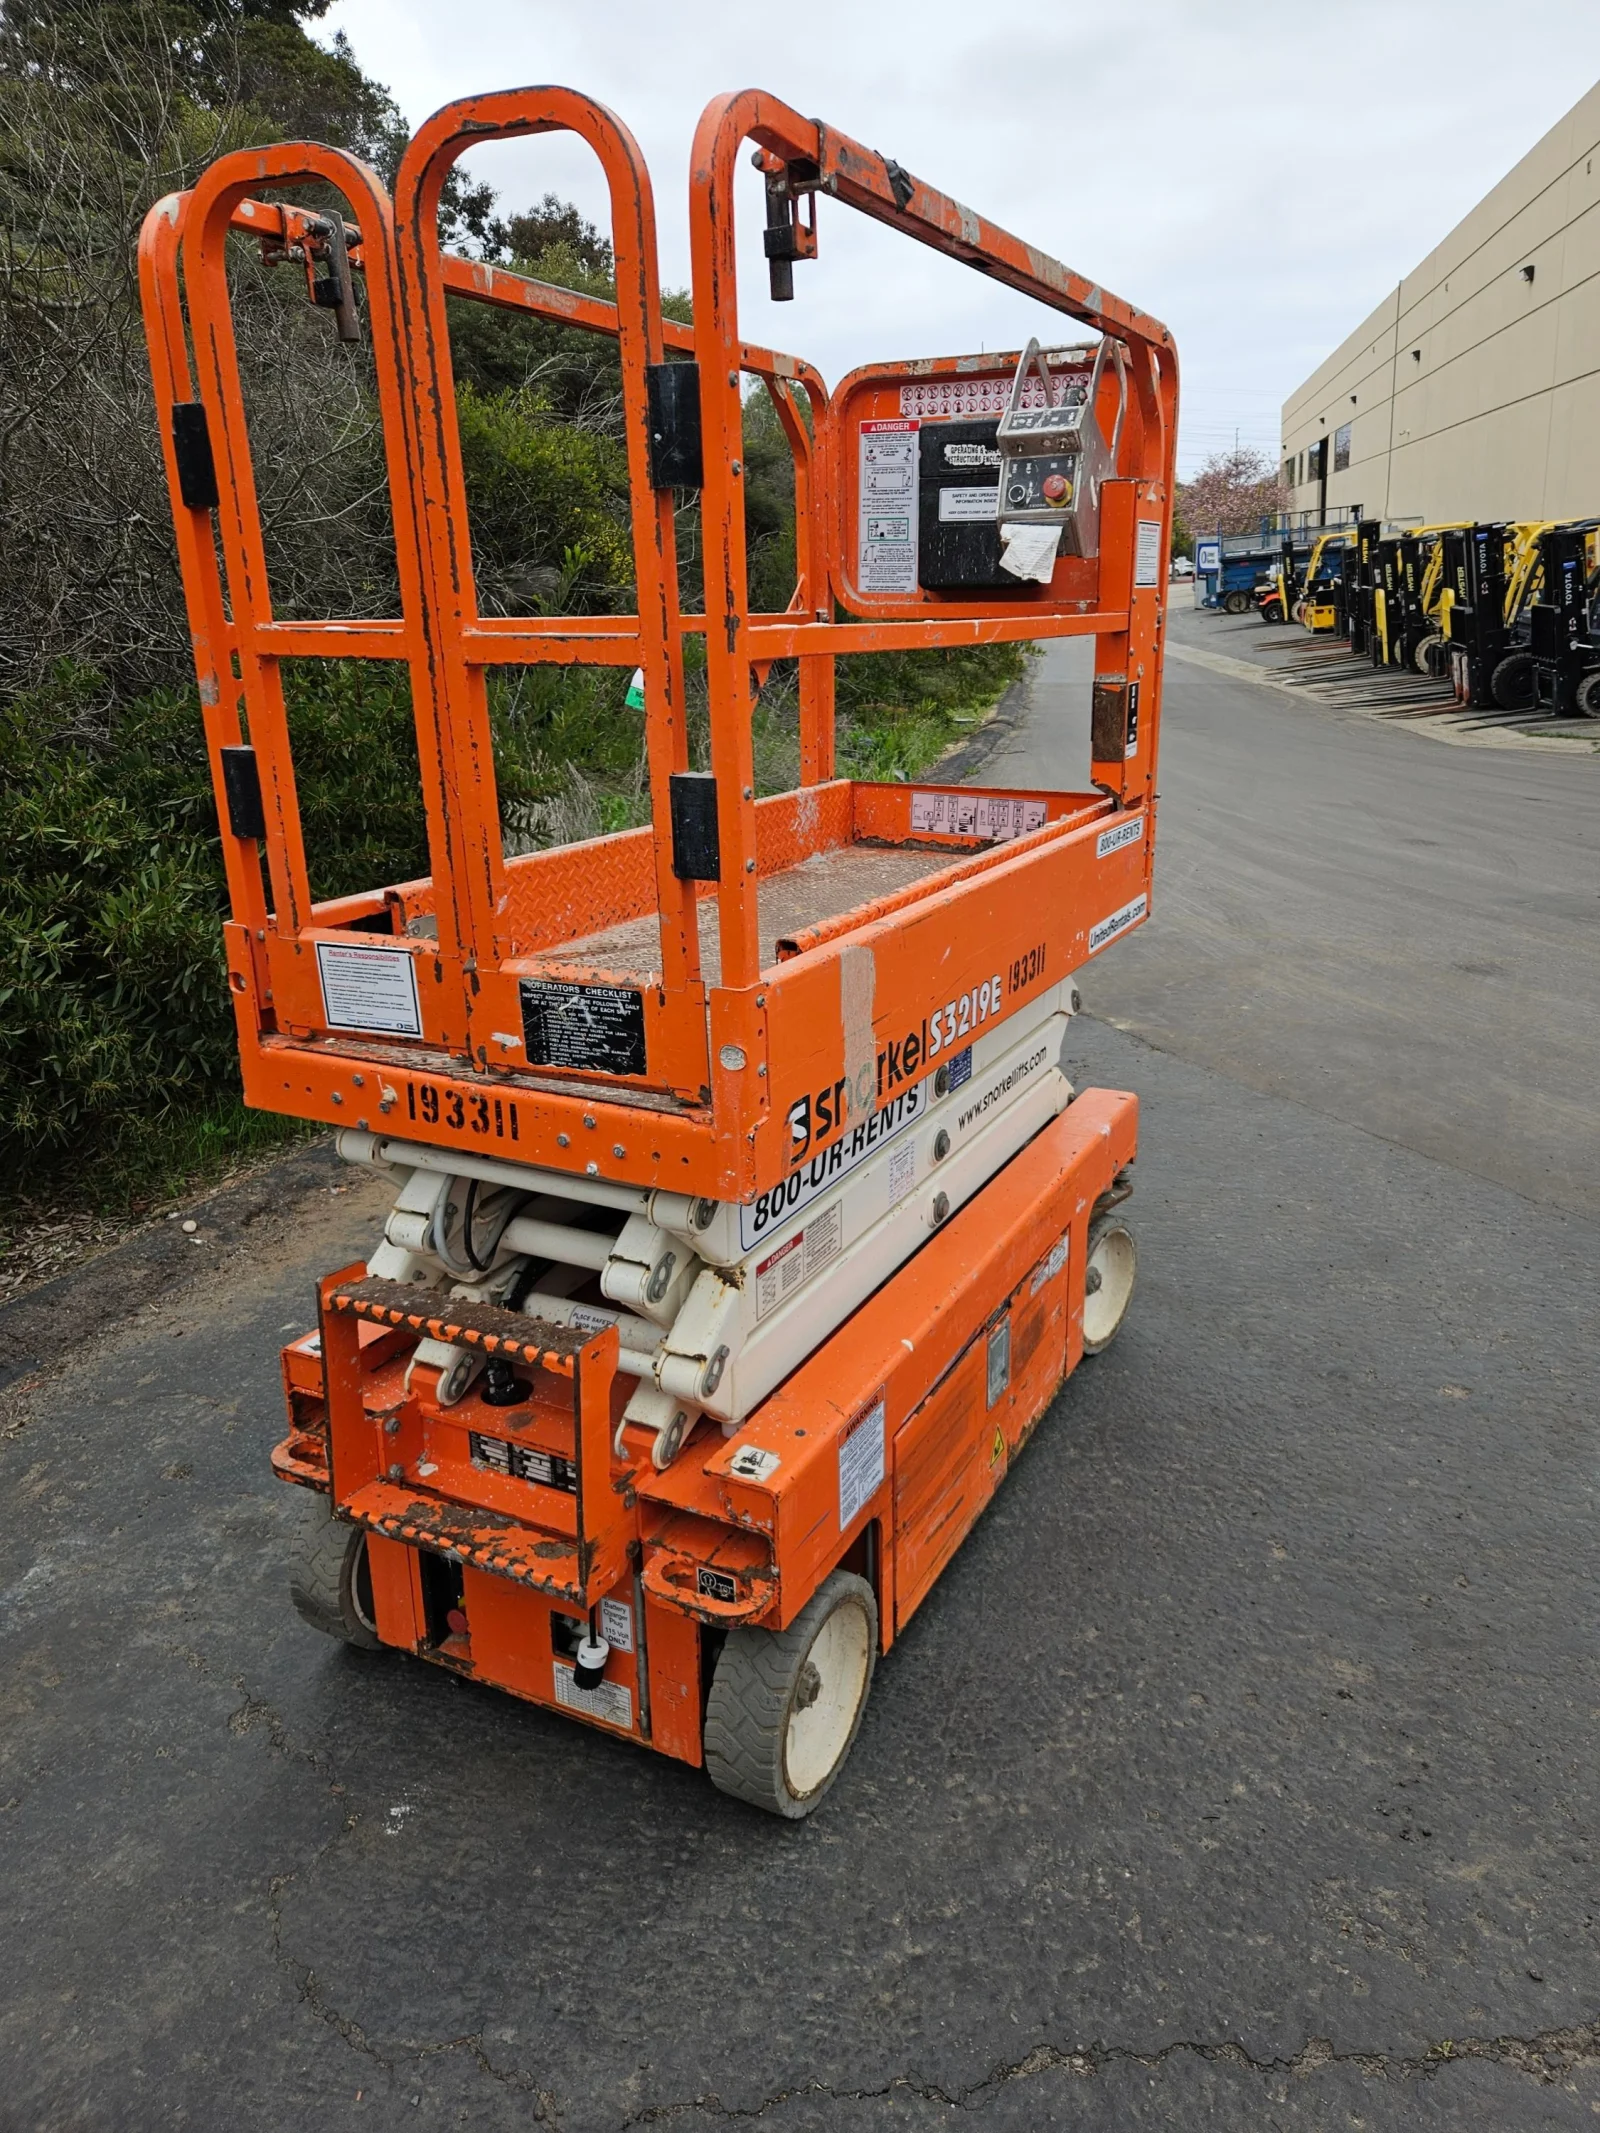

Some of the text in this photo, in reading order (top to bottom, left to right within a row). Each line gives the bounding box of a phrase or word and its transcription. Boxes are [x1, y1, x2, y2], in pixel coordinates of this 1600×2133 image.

[876, 422, 910, 432] DANGER
[1385, 564, 1393, 590] HYSTER
[1406, 563, 1415, 592] HYSTER
[1457, 566, 1467, 600] HYSTER
[1100, 822, 1140, 852] 800-UR-RENTS
[1090, 902, 1146, 948] UnitedRentals.com
[328, 950, 400, 962] Renter's Responsibilities
[1008, 942, 1046, 996] 193311
[530, 981, 632, 999] OPERATORS CHECKLIST
[592, 1000, 622, 1008] FOLLOWIN
[930, 974, 1002, 1058] S3219E
[958, 1046, 1047, 1132] www.snorkellifts.com
[407, 1082, 519, 1141] 193311
[753, 1084, 919, 1232] 800-UR-RENTS
[770, 1240, 794, 1264] DANGER
[850, 1395, 878, 1432] WARNING
[603, 1609, 628, 1621] Charger
[604, 1601, 626, 1613] Battery
[605, 1627, 629, 1639] 115 Volt
[609, 1617, 623, 1628] Plug
[608, 1635, 627, 1646] ONLY
